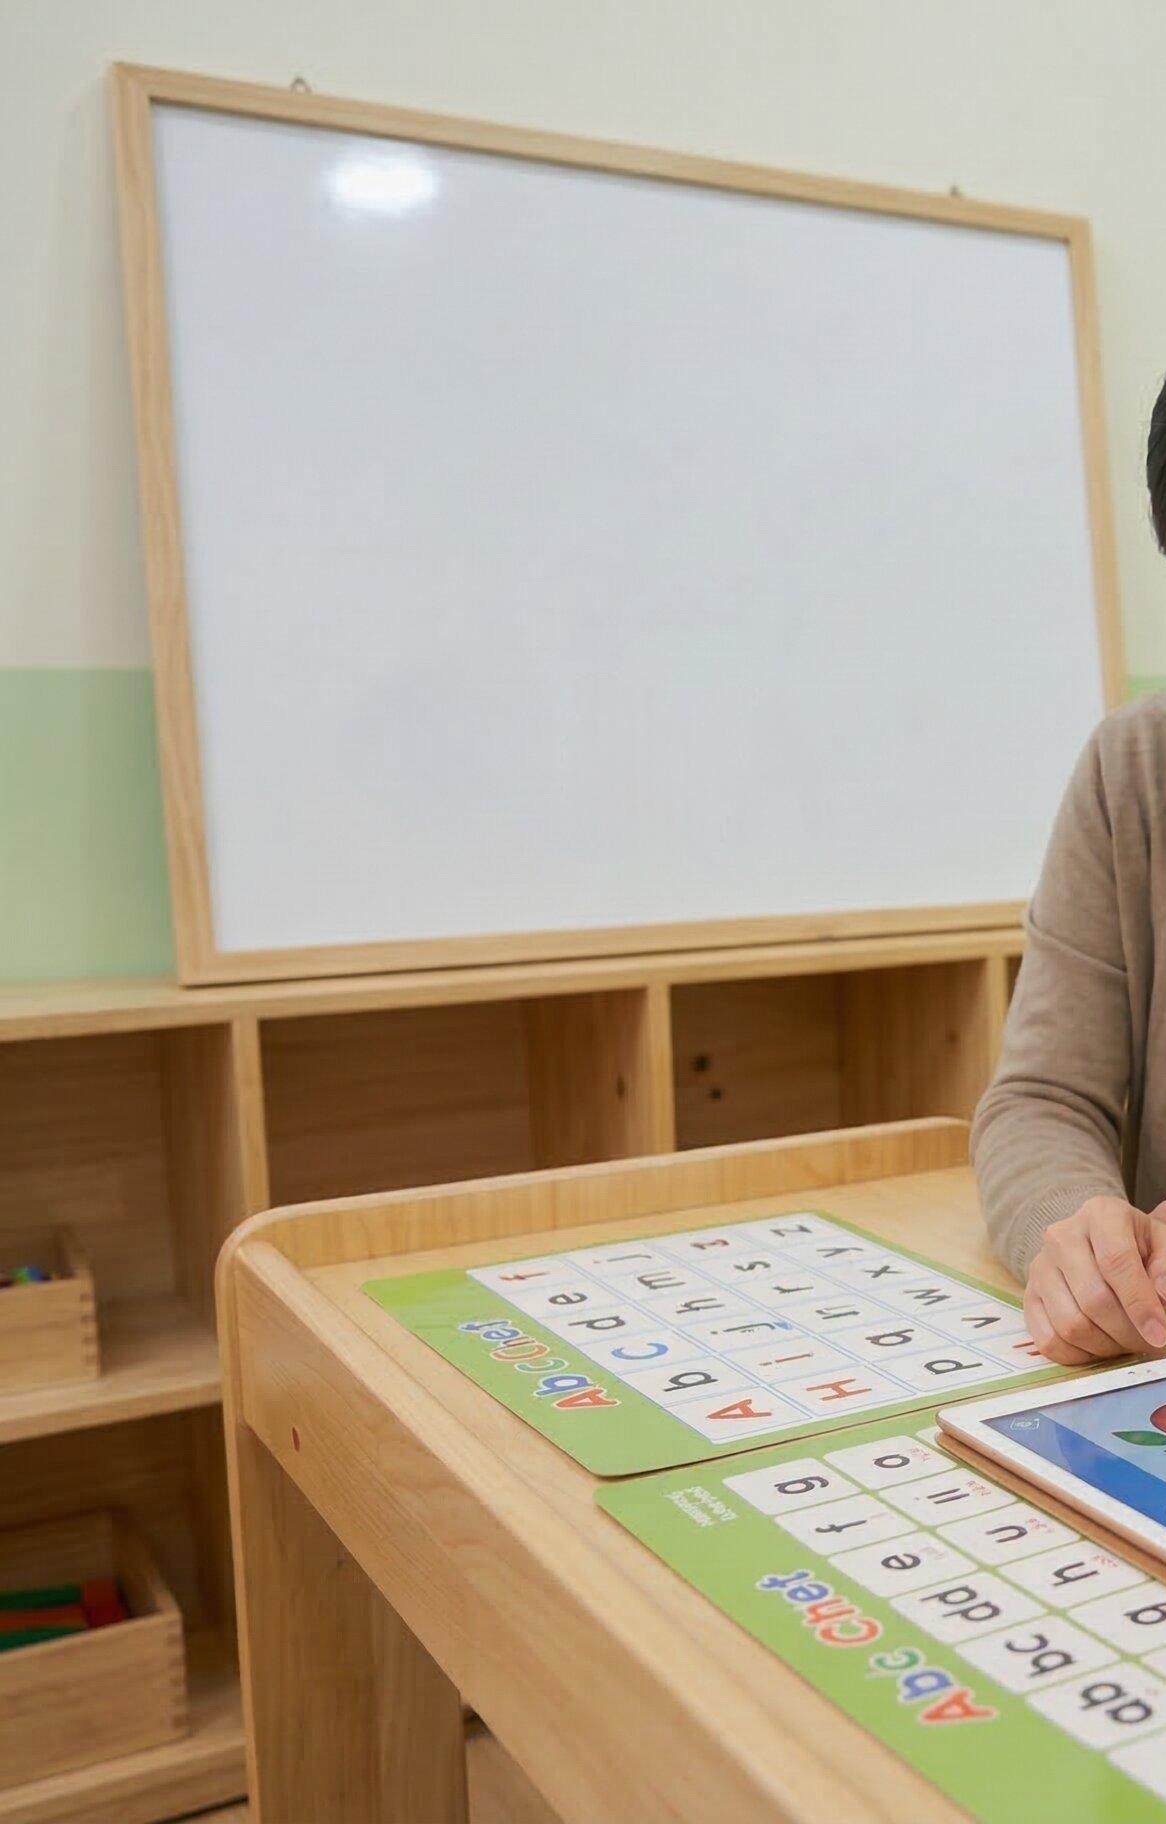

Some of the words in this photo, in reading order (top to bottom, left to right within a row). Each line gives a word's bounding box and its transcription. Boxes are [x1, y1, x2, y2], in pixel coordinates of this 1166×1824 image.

[636, 1272, 686, 1291] m
[863, 1265, 902, 1279] x
[548, 1292, 588, 1306] e
[675, 1297, 725, 1315] h
[903, 1288, 952, 1306] w
[567, 1315, 626, 1331] d
[961, 1316, 1002, 1329] v
[923, 1359, 983, 1375] p
[663, 1371, 719, 1393] b
[805, 1378, 873, 1402] H
[705, 1398, 772, 1420] A
[773, 1475, 830, 1495] g
[814, 1519, 868, 1534] f
[985, 1525, 1028, 1544] u
[880, 1553, 921, 1571] e
[1052, 1561, 1100, 1587] h
[920, 1585, 1001, 1622] dd
[1005, 1633, 1076, 1678] bc
[871, 1648, 996, 1723] Abc
[1079, 1682, 1154, 1725] ab
